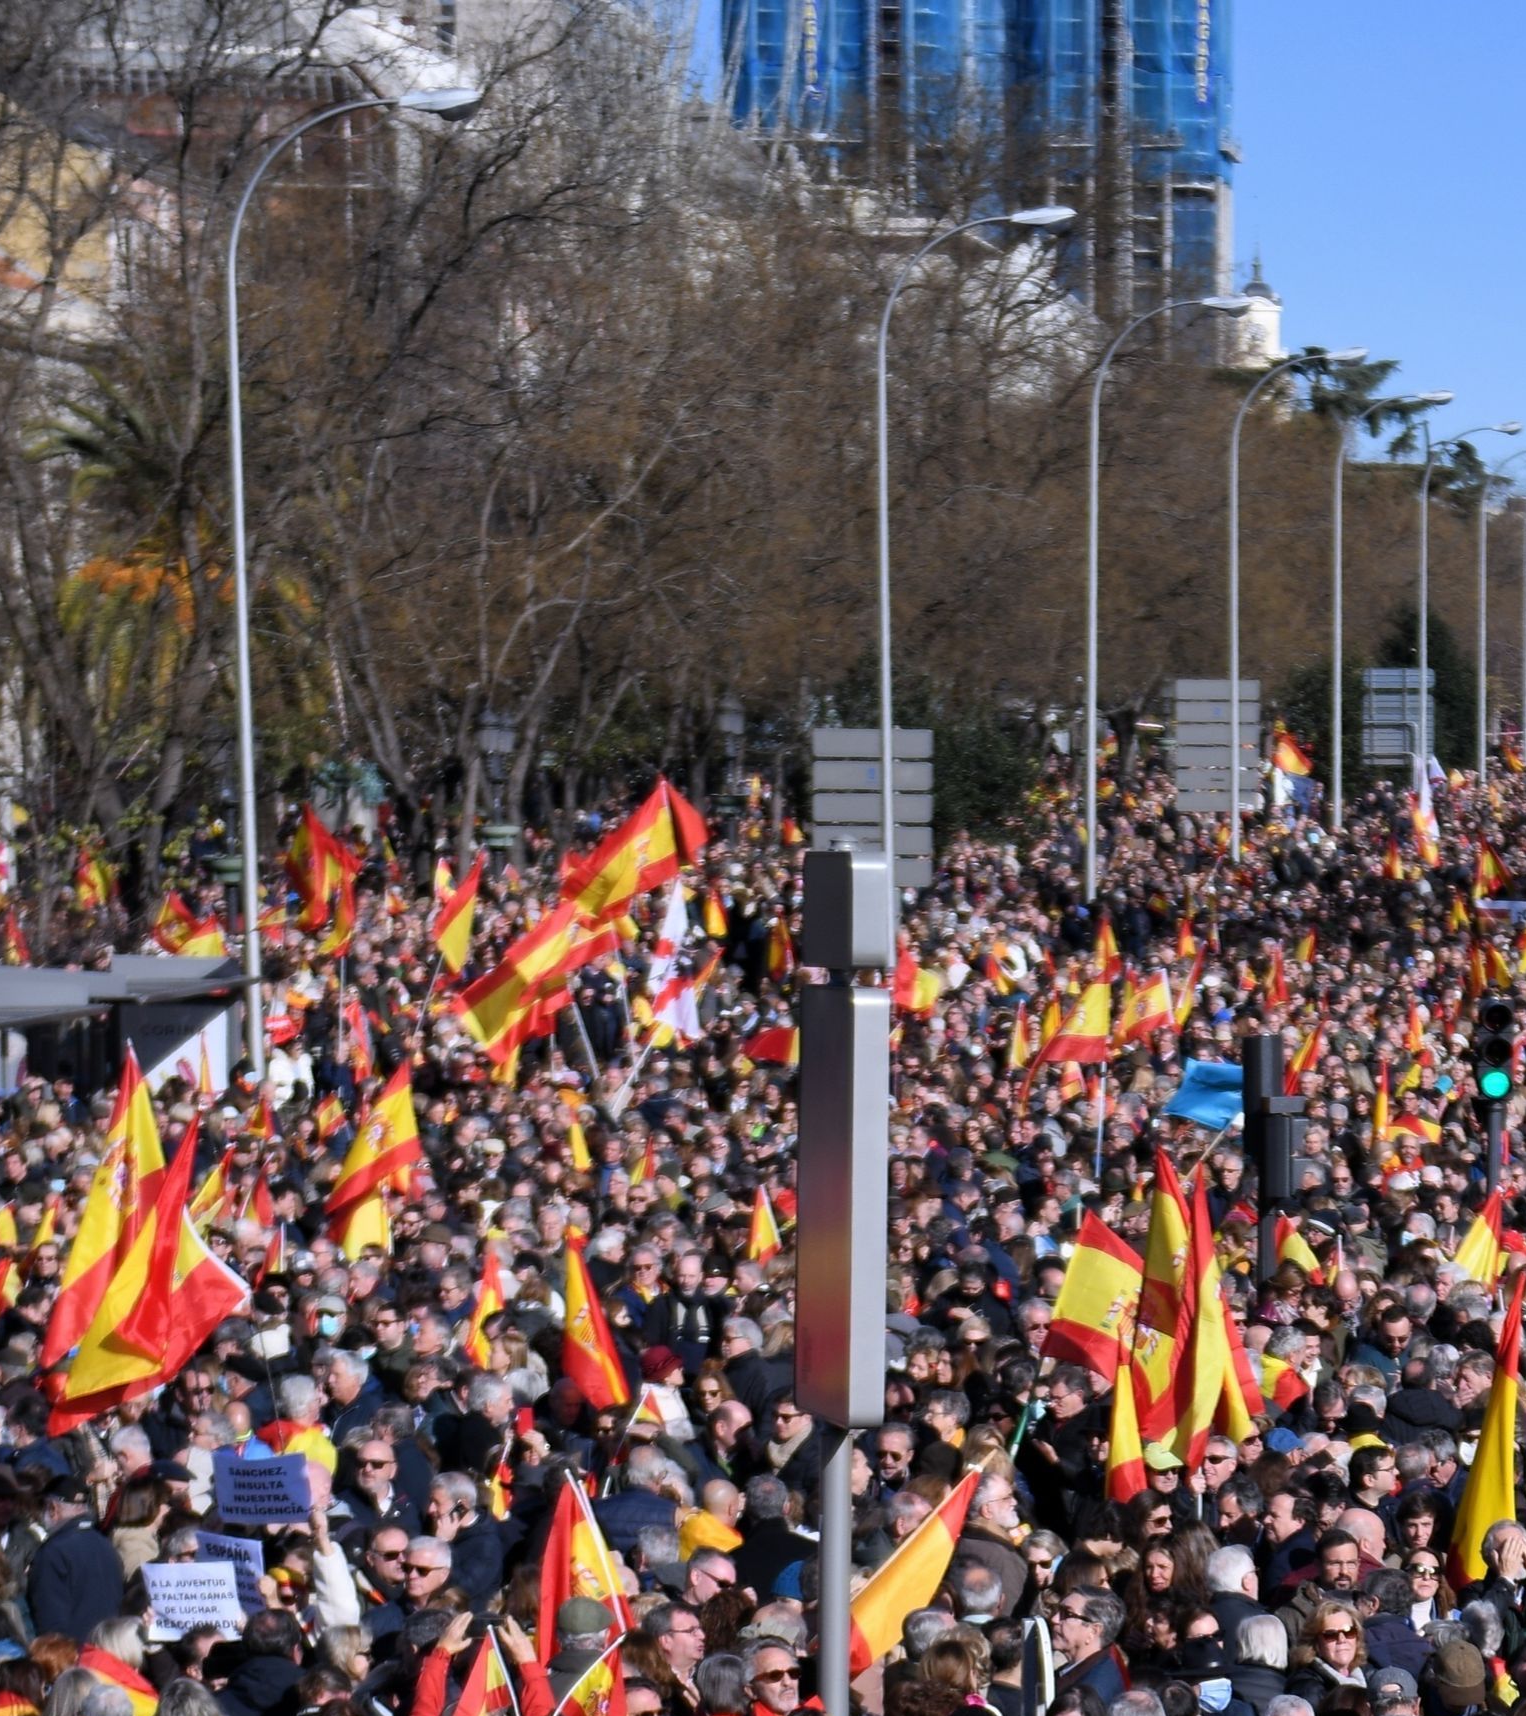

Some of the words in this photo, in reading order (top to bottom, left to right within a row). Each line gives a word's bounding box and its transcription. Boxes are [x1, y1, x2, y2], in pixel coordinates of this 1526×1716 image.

[234, 1494, 289, 1503] NUESTRA
[205, 1543, 251, 1563] ESPAÑA
[175, 1578, 226, 1588] JUVENTUD
[162, 1592, 197, 1601] FALTAN
[200, 1590, 234, 1600] GANAS
[164, 1605, 177, 1615] DE
